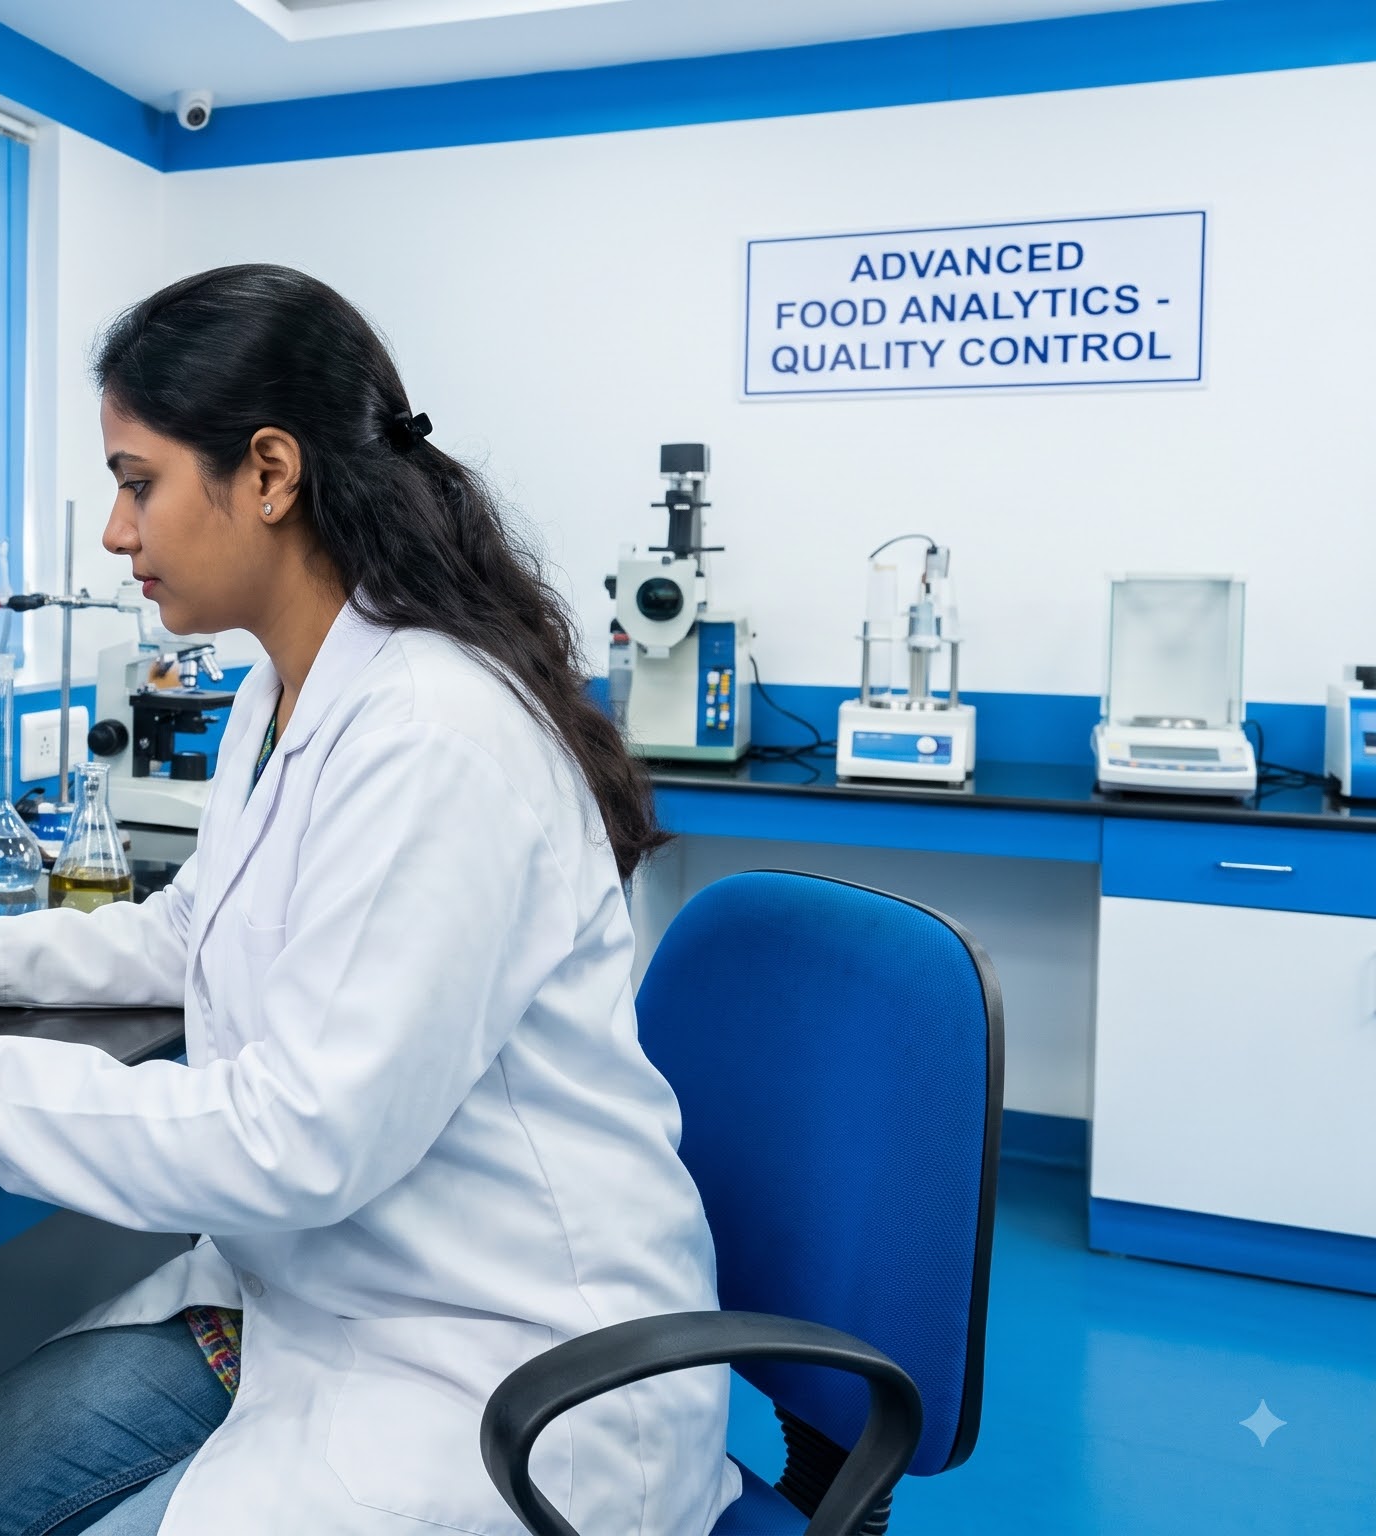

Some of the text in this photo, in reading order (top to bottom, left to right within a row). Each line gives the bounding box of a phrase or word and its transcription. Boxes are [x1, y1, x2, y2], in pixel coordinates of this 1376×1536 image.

[850, 241, 1085, 283] ADVANCED
[776, 298, 888, 330] FOOD
[899, 285, 1141, 324] ANALYTICS
[771, 330, 1172, 375] QUALITY CONTROL
